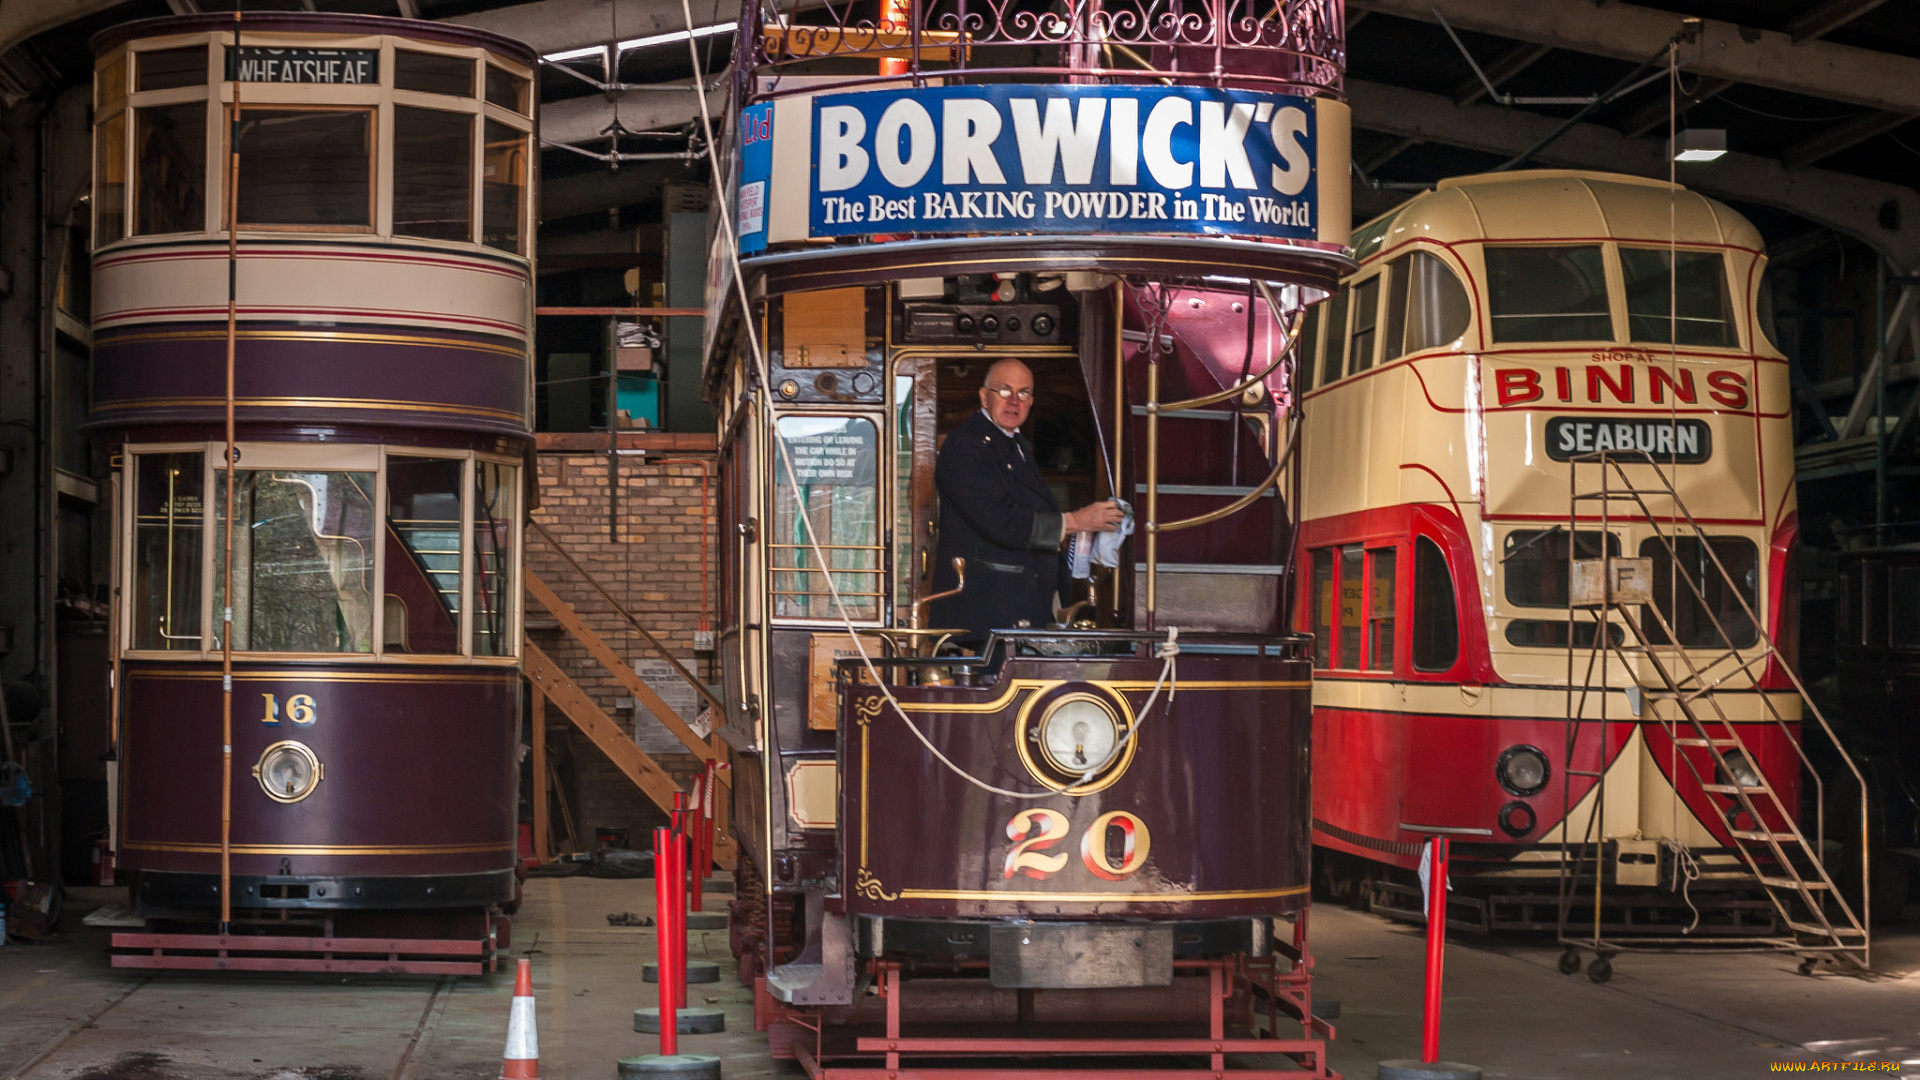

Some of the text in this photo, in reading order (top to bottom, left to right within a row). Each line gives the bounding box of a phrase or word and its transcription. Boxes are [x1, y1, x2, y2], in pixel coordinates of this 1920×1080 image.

[238, 60, 369, 83] WHEATSHEAF
[744, 108, 772, 145] Ltd
[819, 96, 1311, 196] BORWICK'S
[822, 191, 1311, 227] The Best BAKING POWDER in The World
[1591, 352, 1656, 364] SHOP AT
[1495, 364, 1748, 409] BINNS
[795, 446, 808, 455] THE
[809, 446, 824, 455] CAR
[825, 446, 847, 455] WHILE
[835, 436, 863, 445] LEAVING
[1558, 422, 1699, 455] SEABURN
[795, 458, 822, 467] MOTION
[836, 458, 846, 467] SO
[796, 469, 818, 478] THEIR
[818, 469, 835, 478] OWN
[1617, 567, 1635, 592] F
[834, 648, 864, 657] PLEAS
[261, 693, 317, 727] 16
[1004, 808, 1151, 881] 20
